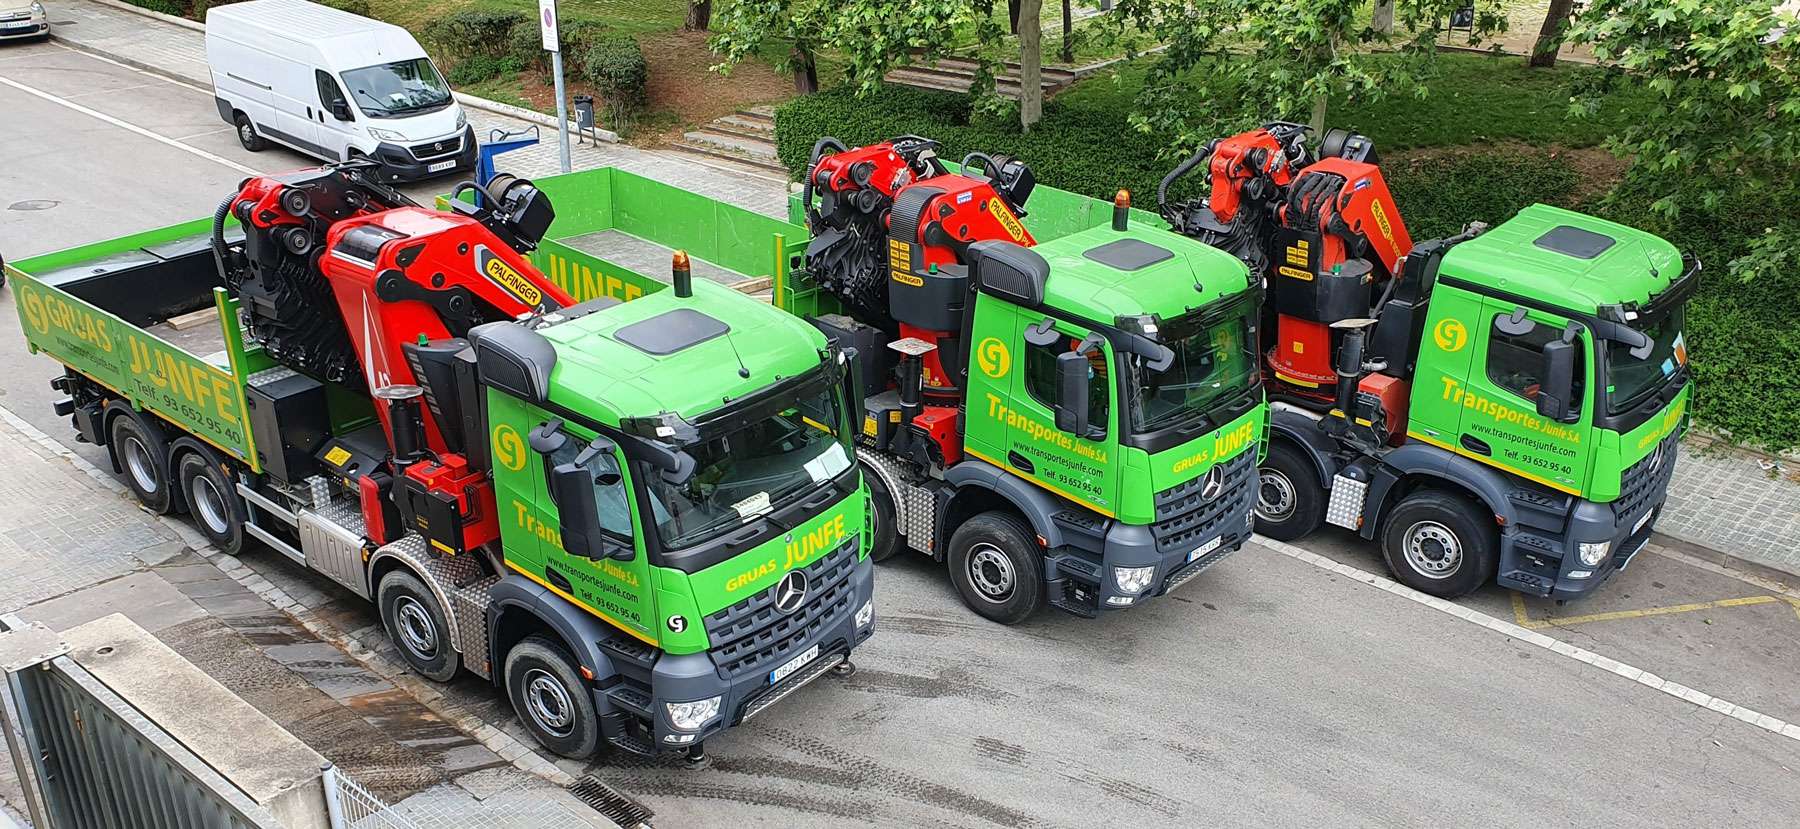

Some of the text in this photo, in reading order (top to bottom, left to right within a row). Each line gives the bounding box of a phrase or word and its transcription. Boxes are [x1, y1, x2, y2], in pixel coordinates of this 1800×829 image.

[991, 200, 1021, 239] PALFINGER
[490, 262, 538, 302] PALFINGER
[893, 272, 921, 285] PALFINGER
[1281, 268, 1311, 279] PALFINGER
[128, 335, 238, 425] JUNFE
[133, 378, 241, 445] Telf. 93 652 95 40
[986, 392, 1072, 449] Transportes
[1073, 439, 1095, 458] Junfe
[1440, 376, 1540, 430] Transportes
[1541, 420, 1567, 441] Junfe
[1013, 440, 1104, 478] www.transportesjunfe.com
[1172, 421, 1254, 474] GRUAS JUNFE
[1471, 422, 1577, 458] www.transportesjunfe.com
[1043, 467, 1102, 496] Telf. 93 652 95 40
[1504, 448, 1572, 475] Telf. 93 652 95 40
[512, 499, 602, 570] Transs
[726, 560, 777, 592] GRUAS
[783, 514, 845, 570] JUNFE
[546, 555, 639, 604] www.transportesjunfe.com
[580, 588, 640, 623] Telf. 93 652 95 40
